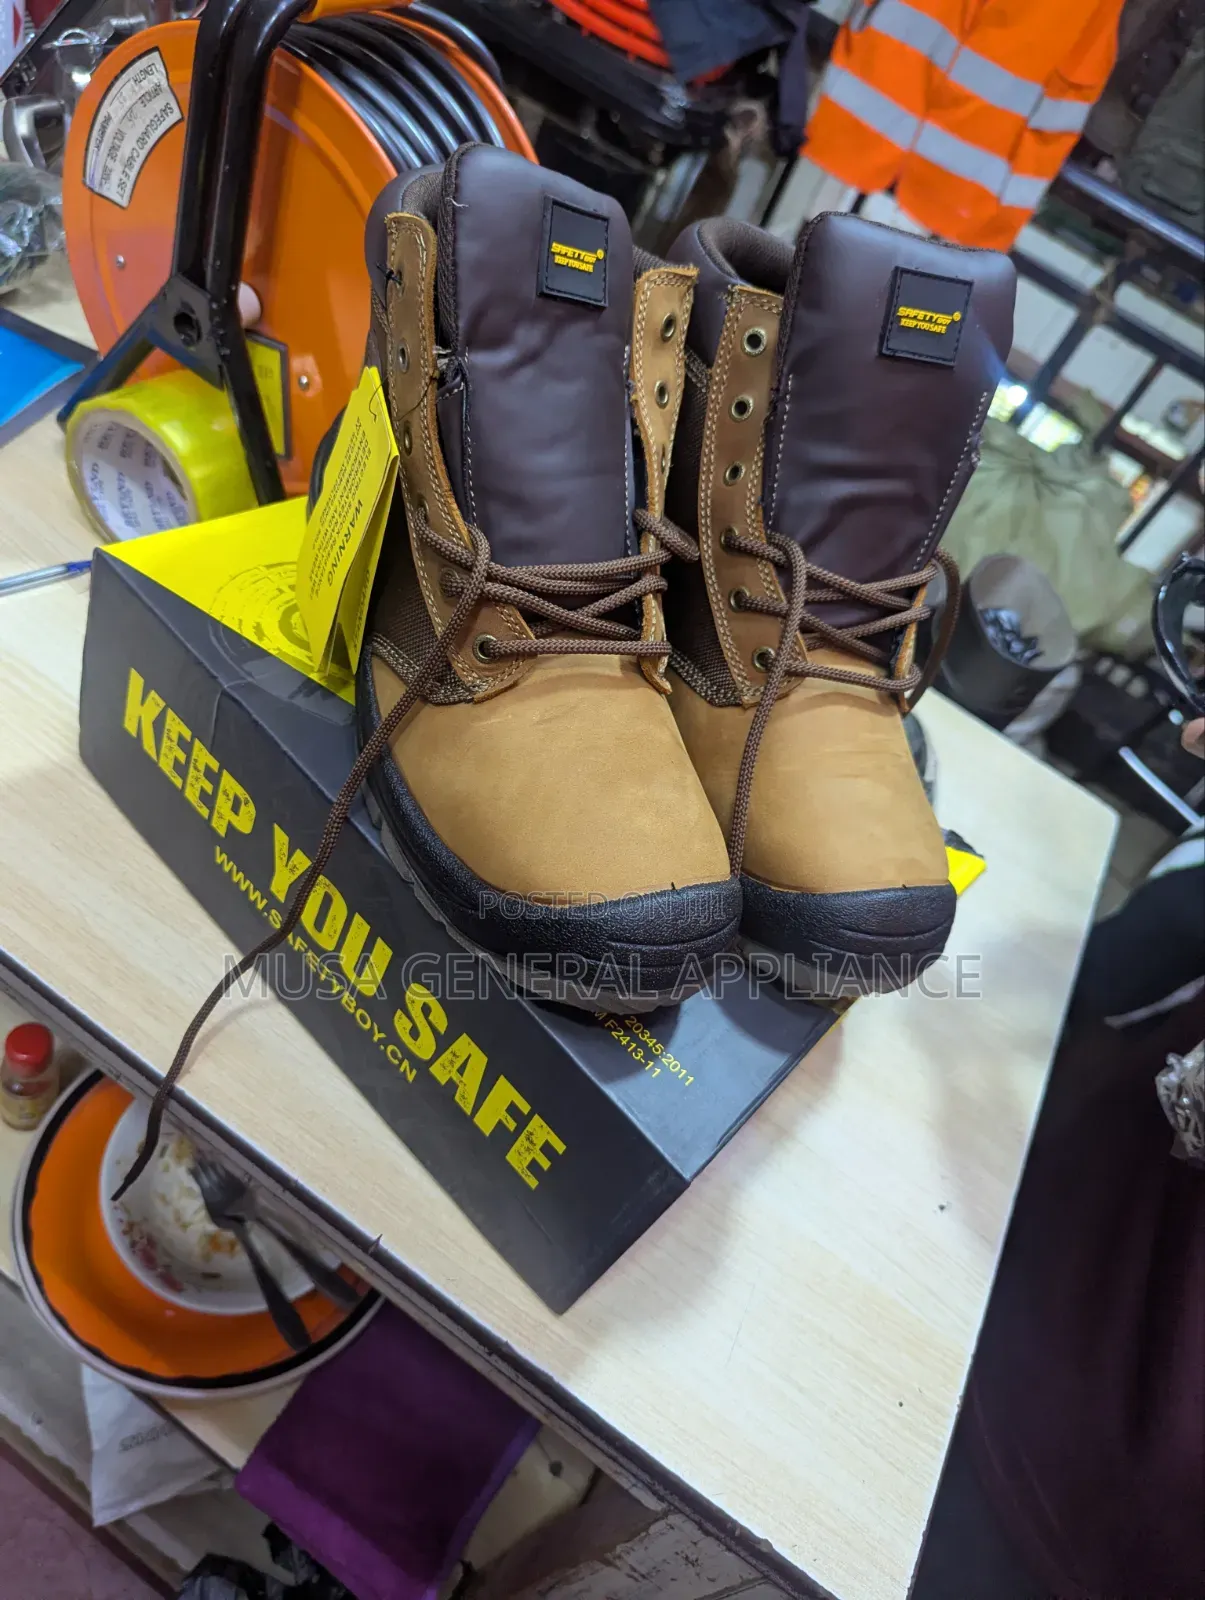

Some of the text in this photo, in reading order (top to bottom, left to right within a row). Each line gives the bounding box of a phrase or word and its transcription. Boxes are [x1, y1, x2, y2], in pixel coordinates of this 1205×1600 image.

[131, 63, 158, 85] LENGTH
[138, 82, 163, 108] ARTICLE
[115, 102, 174, 201] SAFEGUARD CABLE SET
[929, 322, 947, 334] SAFE
[338, 430, 366, 508] ENVIRONMENT
[346, 439, 368, 500] DETERIORATES
[352, 448, 371, 501] ELECTRIC
[328, 499, 363, 588] WARNING
[329, 505, 337, 528] AND
[337, 501, 352, 535] SHOCK
[123, 667, 256, 838] KEEP
[270, 822, 393, 997] YOU
[393, 982, 567, 1190] SAFE
[605, 1019, 661, 1078] F2413-11
[625, 1015, 694, 1087] 20345:2011
